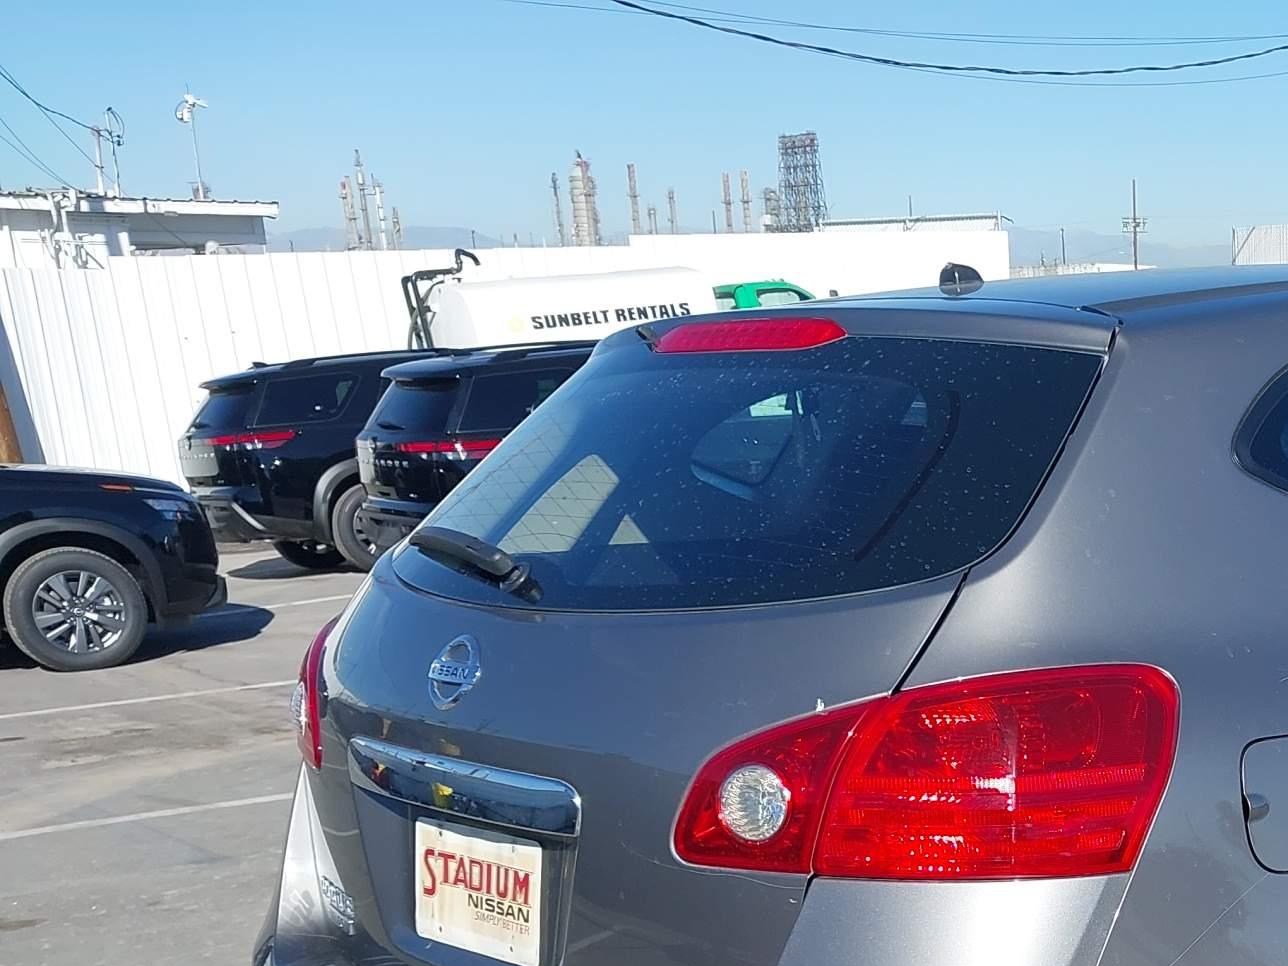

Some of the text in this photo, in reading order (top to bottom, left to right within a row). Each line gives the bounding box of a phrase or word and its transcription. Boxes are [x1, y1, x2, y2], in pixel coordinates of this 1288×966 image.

[530, 302, 691, 330] SUNBELT RENTALS
[423, 848, 532, 907] STADIUM
[467, 893, 530, 923] NISSAN
